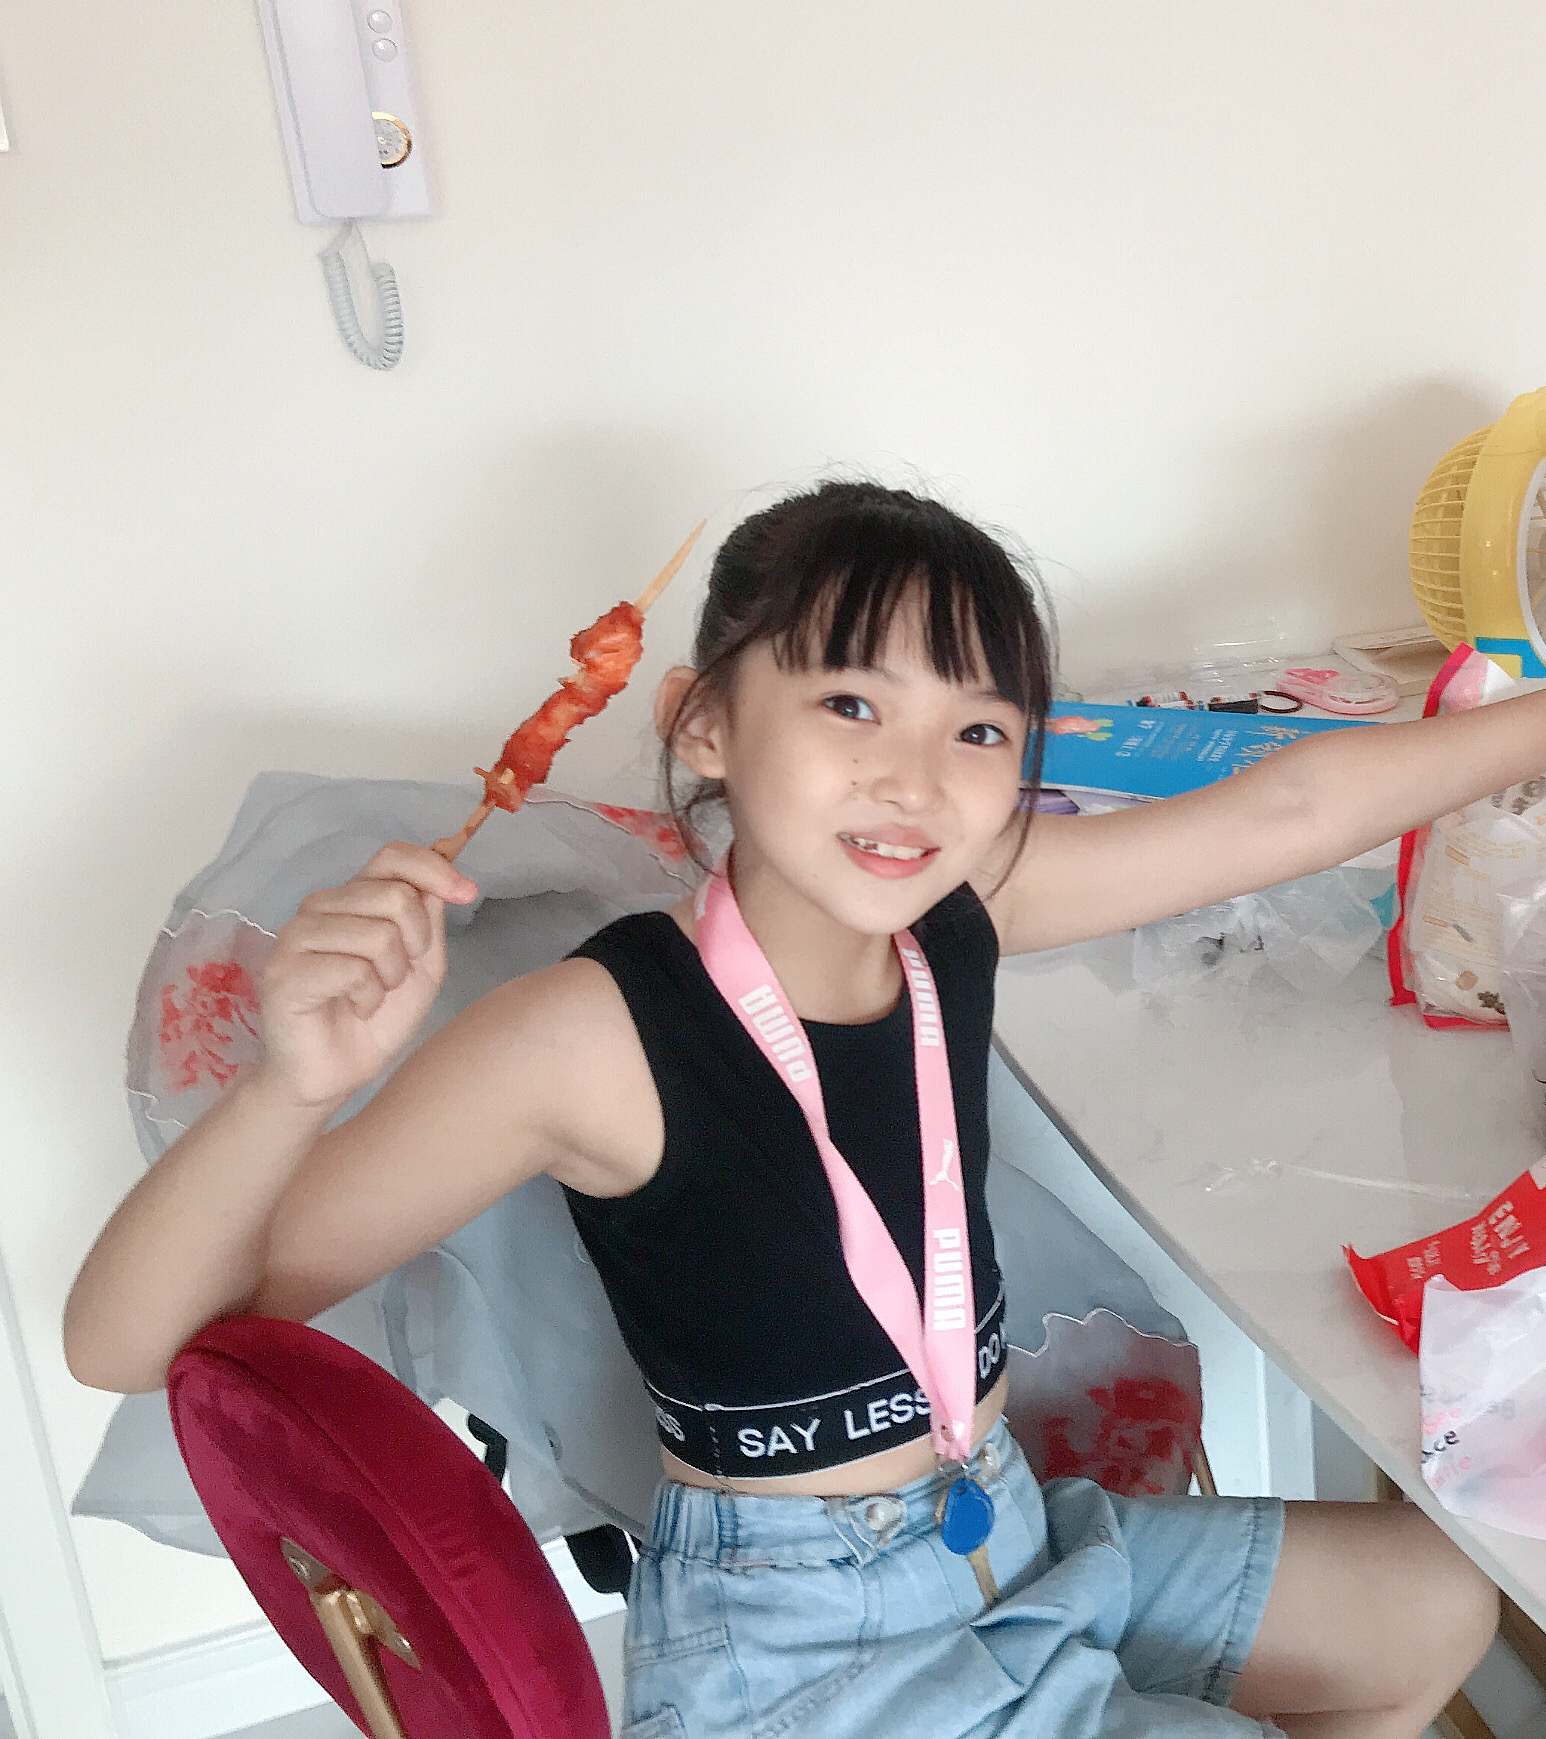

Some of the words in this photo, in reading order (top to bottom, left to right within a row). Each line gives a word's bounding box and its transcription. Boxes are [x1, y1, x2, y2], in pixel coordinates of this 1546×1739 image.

[932, 1227, 967, 1331] PUMA
[737, 1417, 822, 1458] SAY
[844, 1389, 932, 1440] LESS
